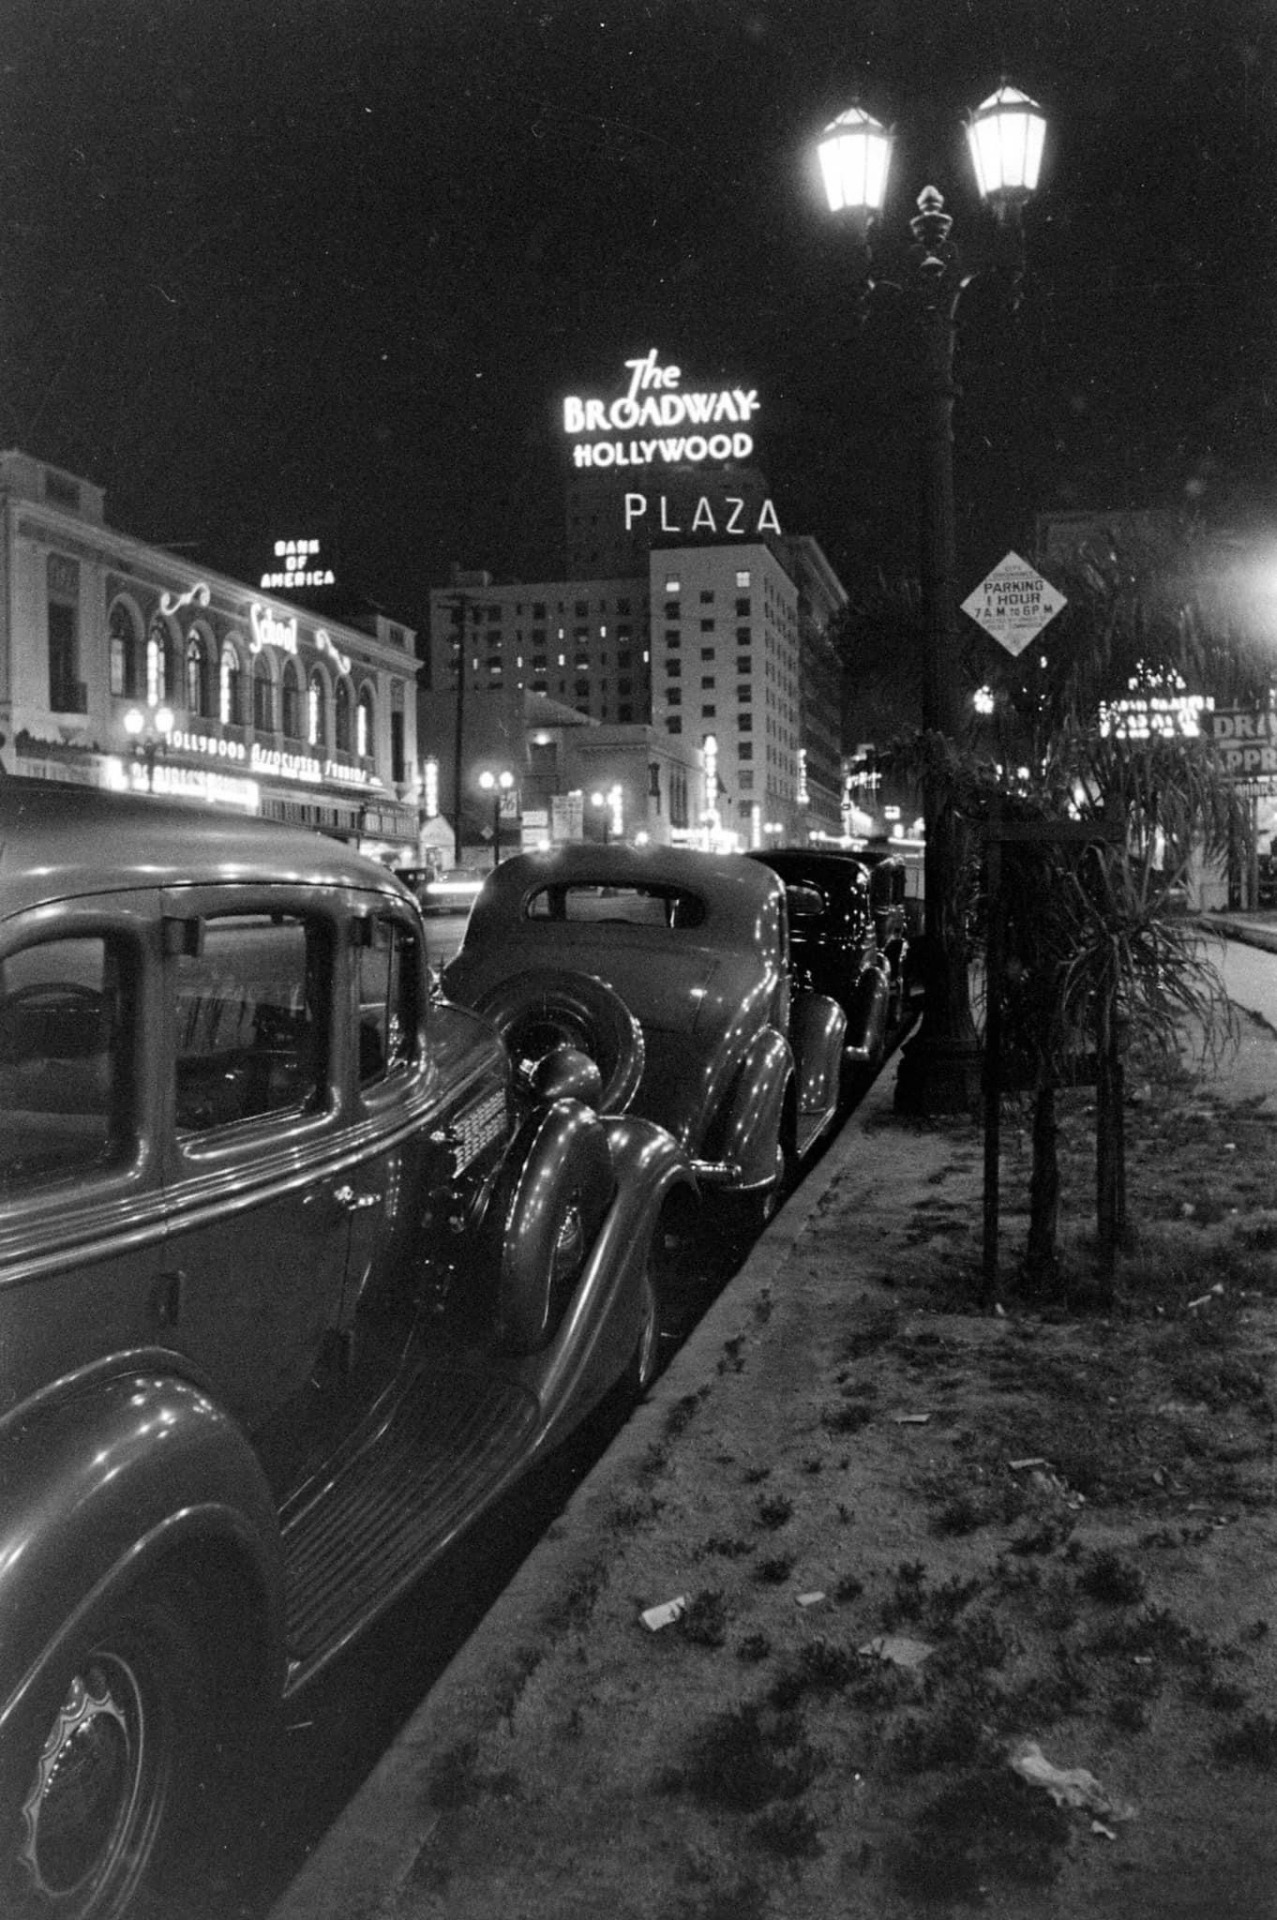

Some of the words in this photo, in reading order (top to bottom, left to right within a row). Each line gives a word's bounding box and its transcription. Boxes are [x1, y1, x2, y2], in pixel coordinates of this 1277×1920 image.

[625, 349, 681, 412] The
[563, 389, 760, 434] BROADWAY
[573, 433, 753, 467] HOLLYWOOD
[624, 493, 782, 535] PLAZA
[274, 539, 320, 556] BANK
[285, 555, 308, 571] OF
[260, 570, 335, 588] AMERICA
[984, 580, 1043, 594] PARKING
[998, 593, 1040, 605] HOUR
